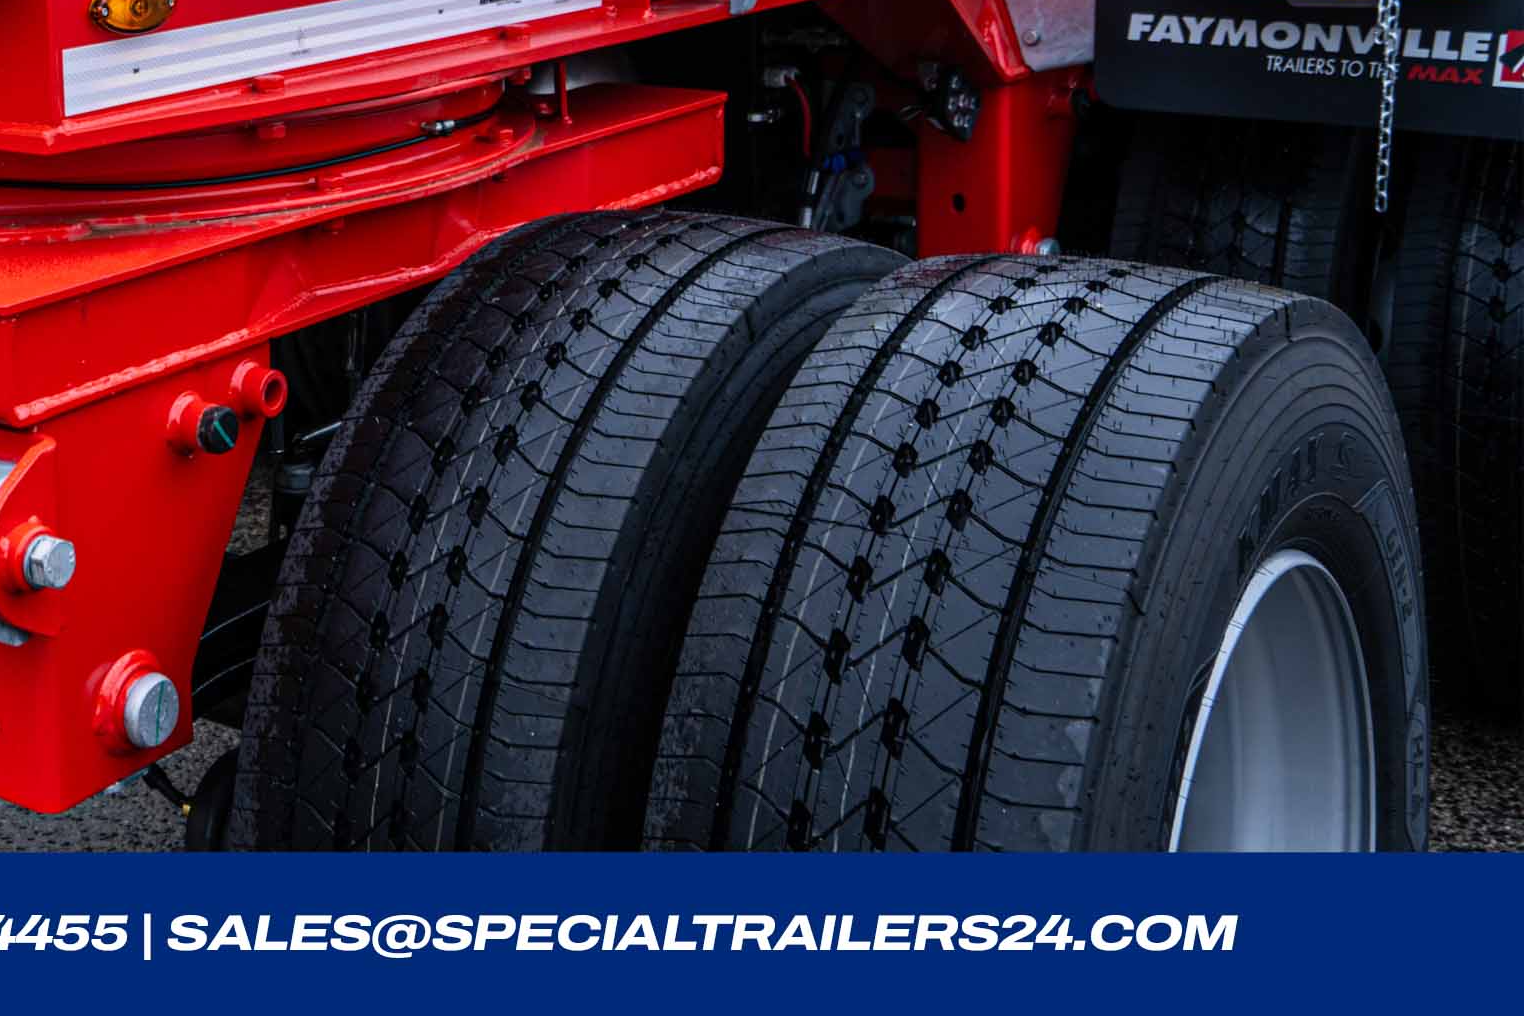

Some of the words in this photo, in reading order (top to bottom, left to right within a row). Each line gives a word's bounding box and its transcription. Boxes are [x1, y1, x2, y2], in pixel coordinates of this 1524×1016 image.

[1266, 55, 1336, 75] TRAILERS
[1341, 59, 1364, 77] TO
[1407, 64, 1485, 84] MAX
